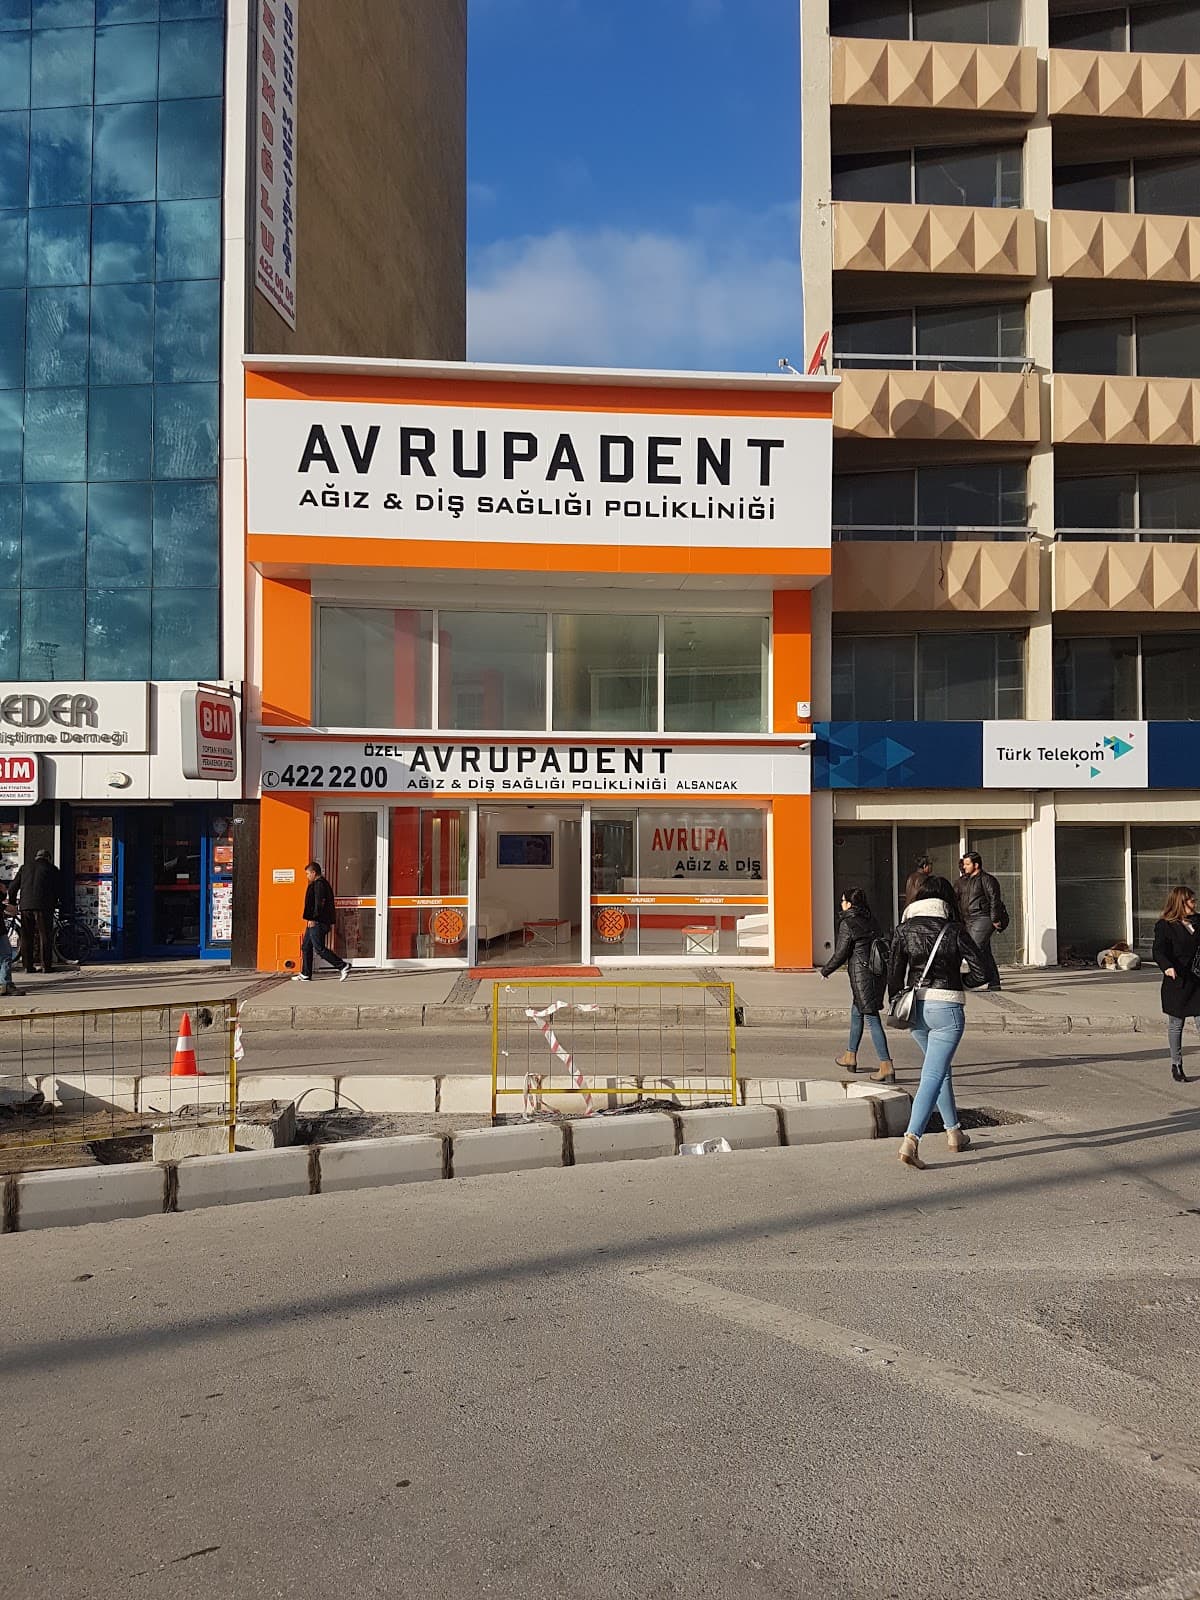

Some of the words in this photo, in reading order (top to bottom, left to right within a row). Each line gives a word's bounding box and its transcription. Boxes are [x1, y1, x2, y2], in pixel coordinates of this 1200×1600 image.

[259, 254, 274, 281] 422
[298, 424, 785, 487] AVRUPADENT
[299, 483, 370, 509] AĞIZ
[383, 493, 403, 510] &
[416, 488, 465, 519] DİŞ
[477, 490, 591, 516] SAĞLIĞI
[605, 495, 775, 520] POLİKLİNİĞİ
[0, 694, 99, 728] EDER
[0, 731, 58, 746] iştirme
[60, 731, 128, 746] Derneği
[364, 742, 402, 757] ÖZEL
[409, 745, 673, 774] AVRUPADENT
[996, 747, 1032, 761] Türk
[1037, 747, 1105, 761] Telekom
[407, 776, 446, 789] AĞIZ
[451, 779, 462, 789] &
[468, 777, 495, 792] DİŞ
[502, 777, 565, 790] SAĞLIĞI
[572, 777, 667, 790] POLİKLİNİĞİ
[676, 780, 738, 790] ALSANCAK
[675, 857, 712, 871] AĞIZ
[719, 860, 729, 871] &
